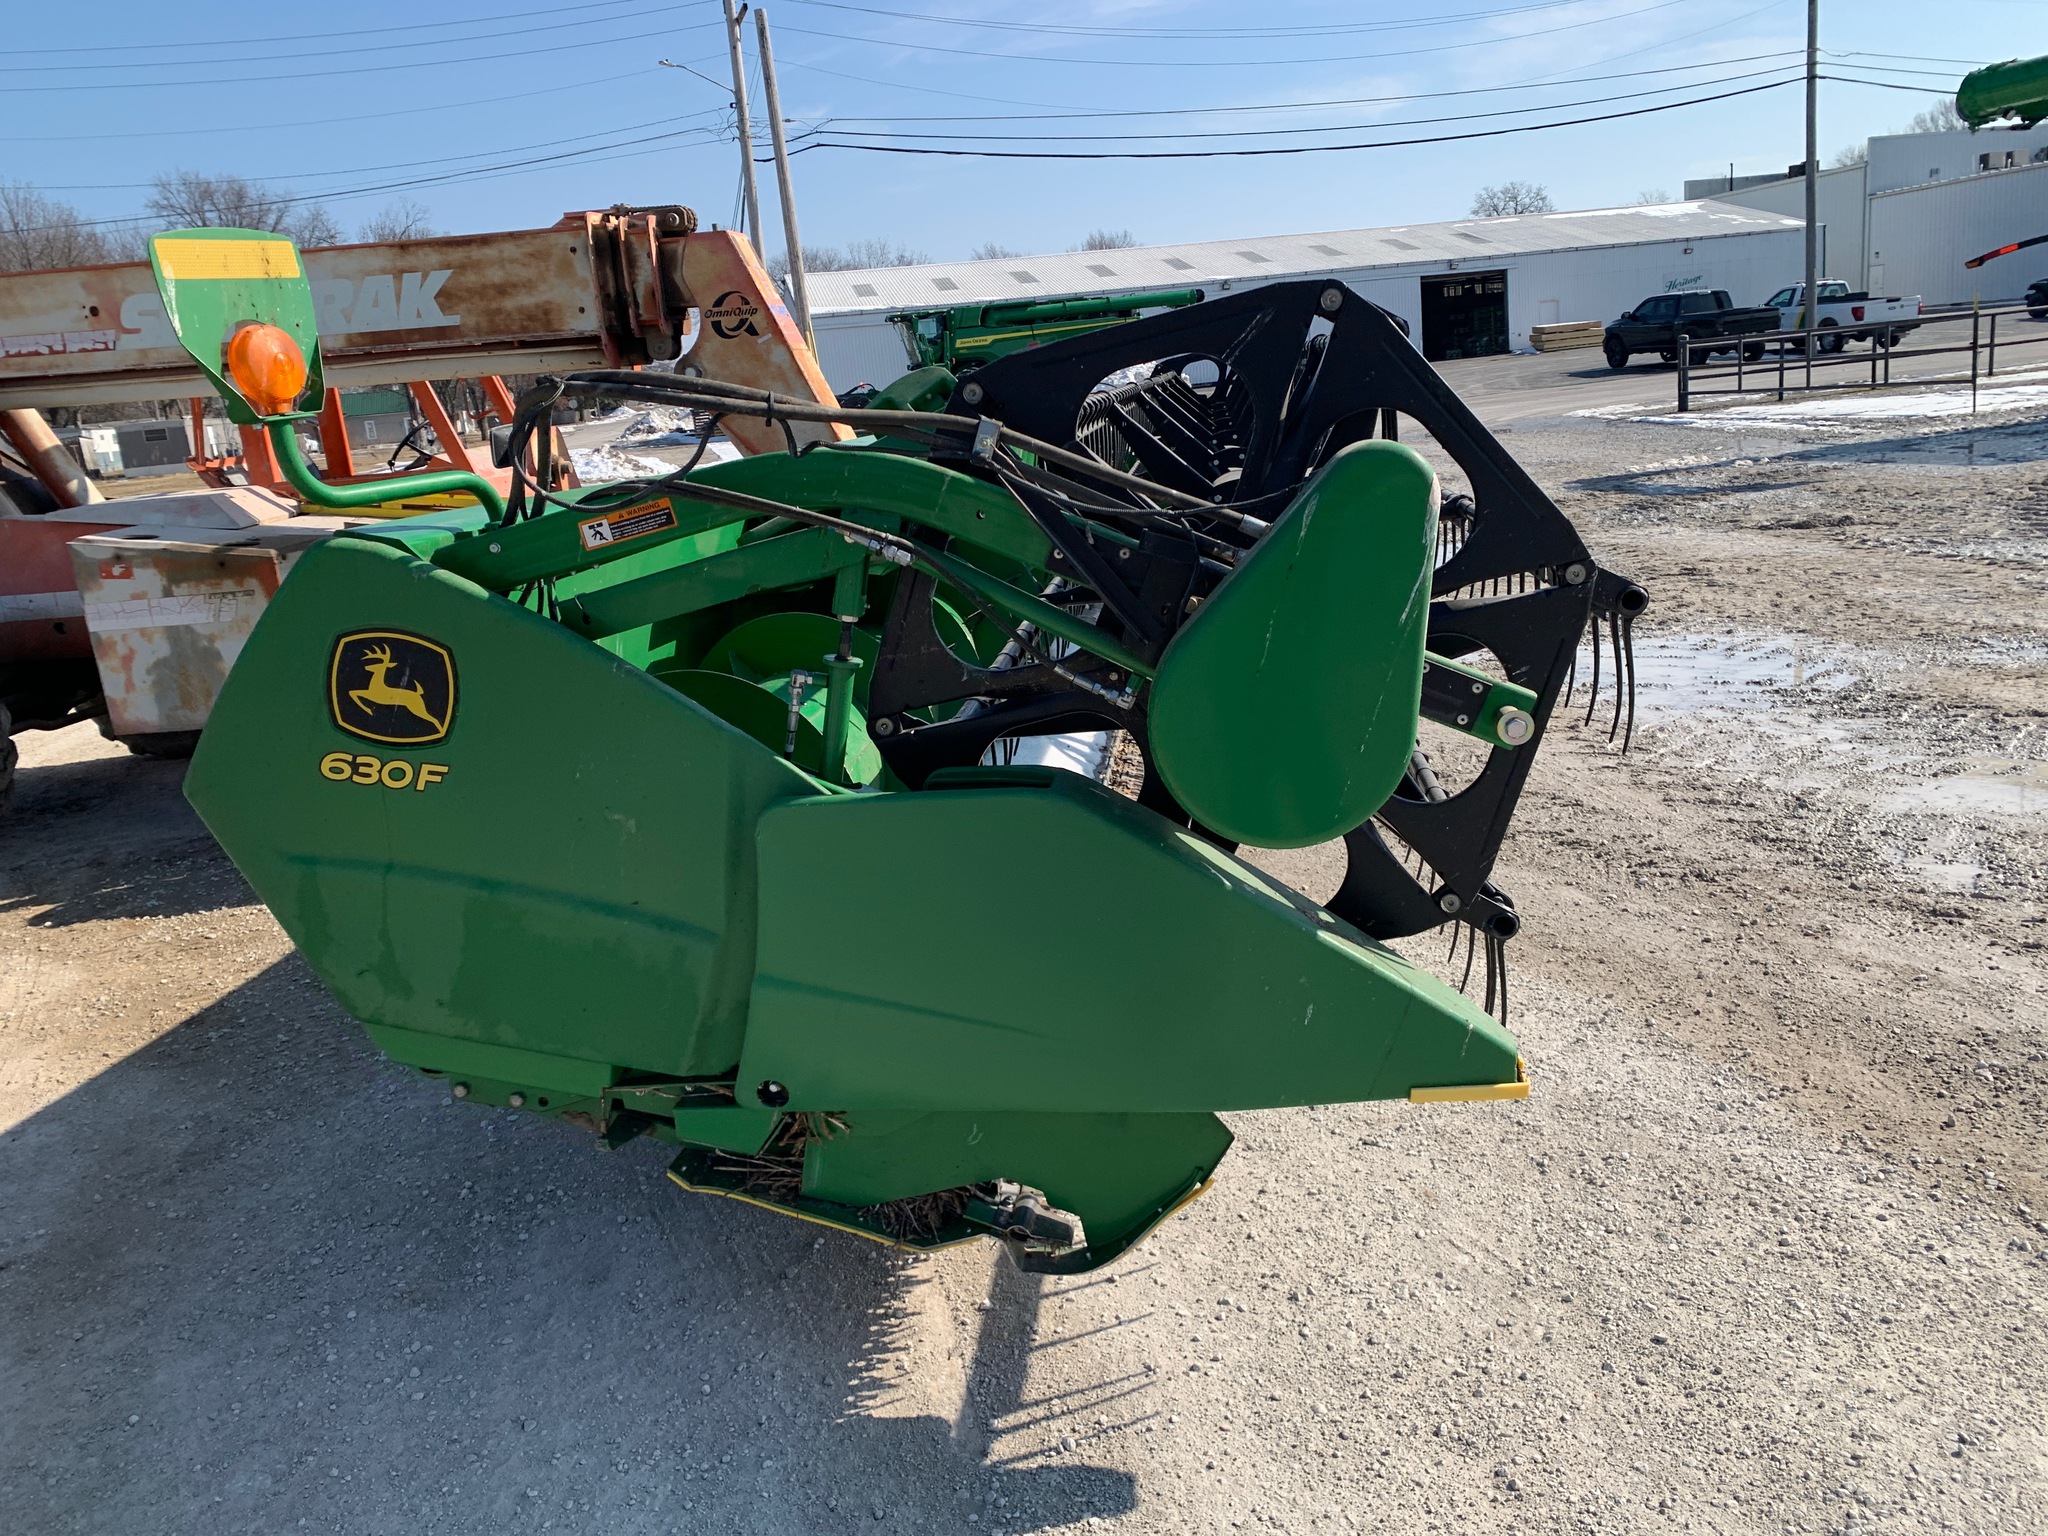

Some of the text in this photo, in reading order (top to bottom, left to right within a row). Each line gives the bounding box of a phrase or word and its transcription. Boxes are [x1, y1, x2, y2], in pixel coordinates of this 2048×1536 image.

[1665, 275, 1703, 291] Heritage
[120, 269, 461, 336] SRAK
[704, 305, 758, 319] OmniQuip
[625, 502, 661, 517] WARNING
[319, 751, 450, 792] 630F
